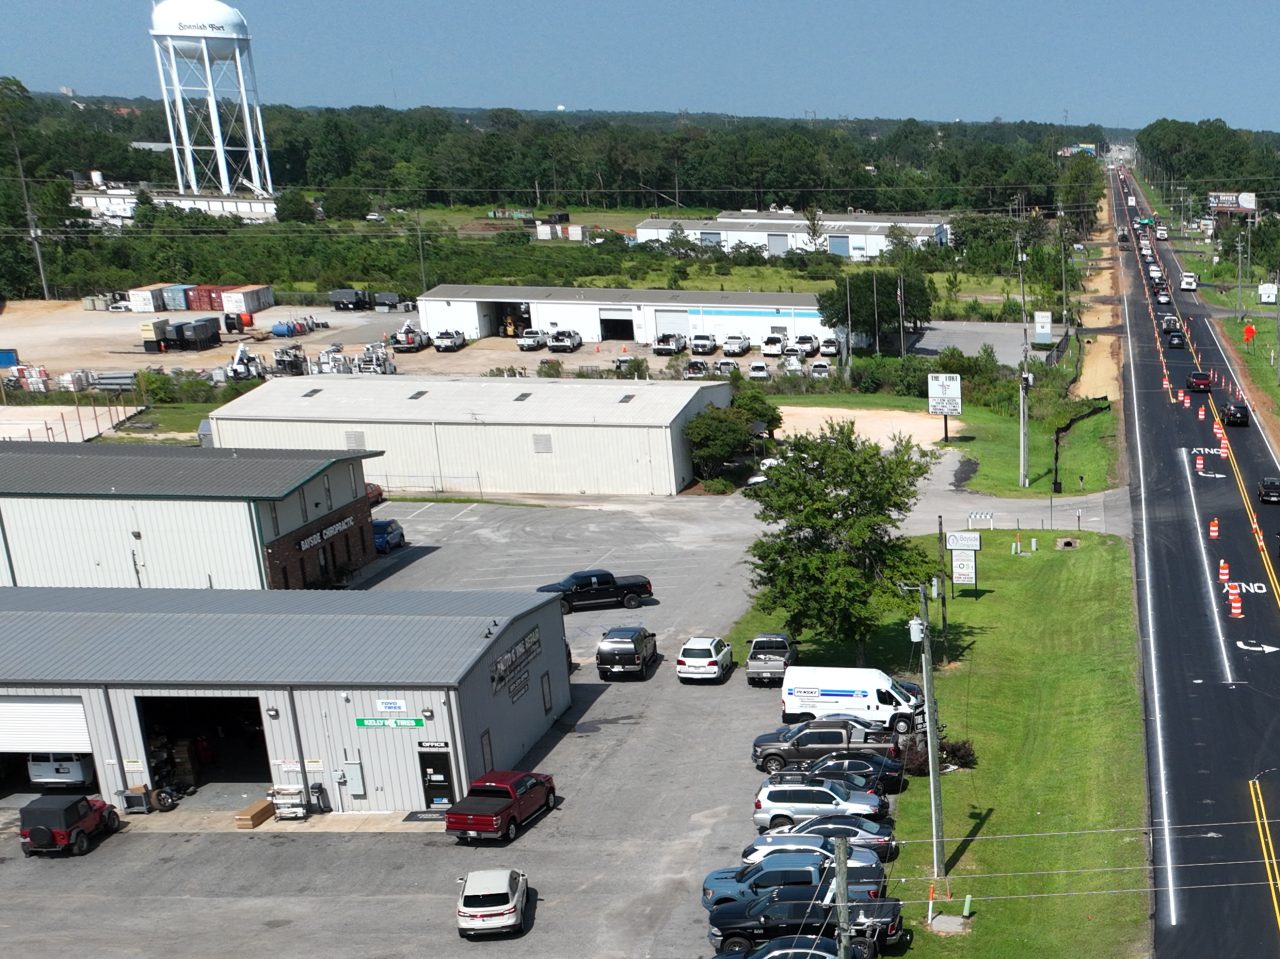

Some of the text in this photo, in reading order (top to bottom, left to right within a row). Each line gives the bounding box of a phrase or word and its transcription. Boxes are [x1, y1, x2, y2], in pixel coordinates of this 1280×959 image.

[178, 22, 226, 31] Spanish Fort
[300, 515, 354, 551] BAYSIDE CHIROPRACTIC
[960, 535, 979, 543] Bayside
